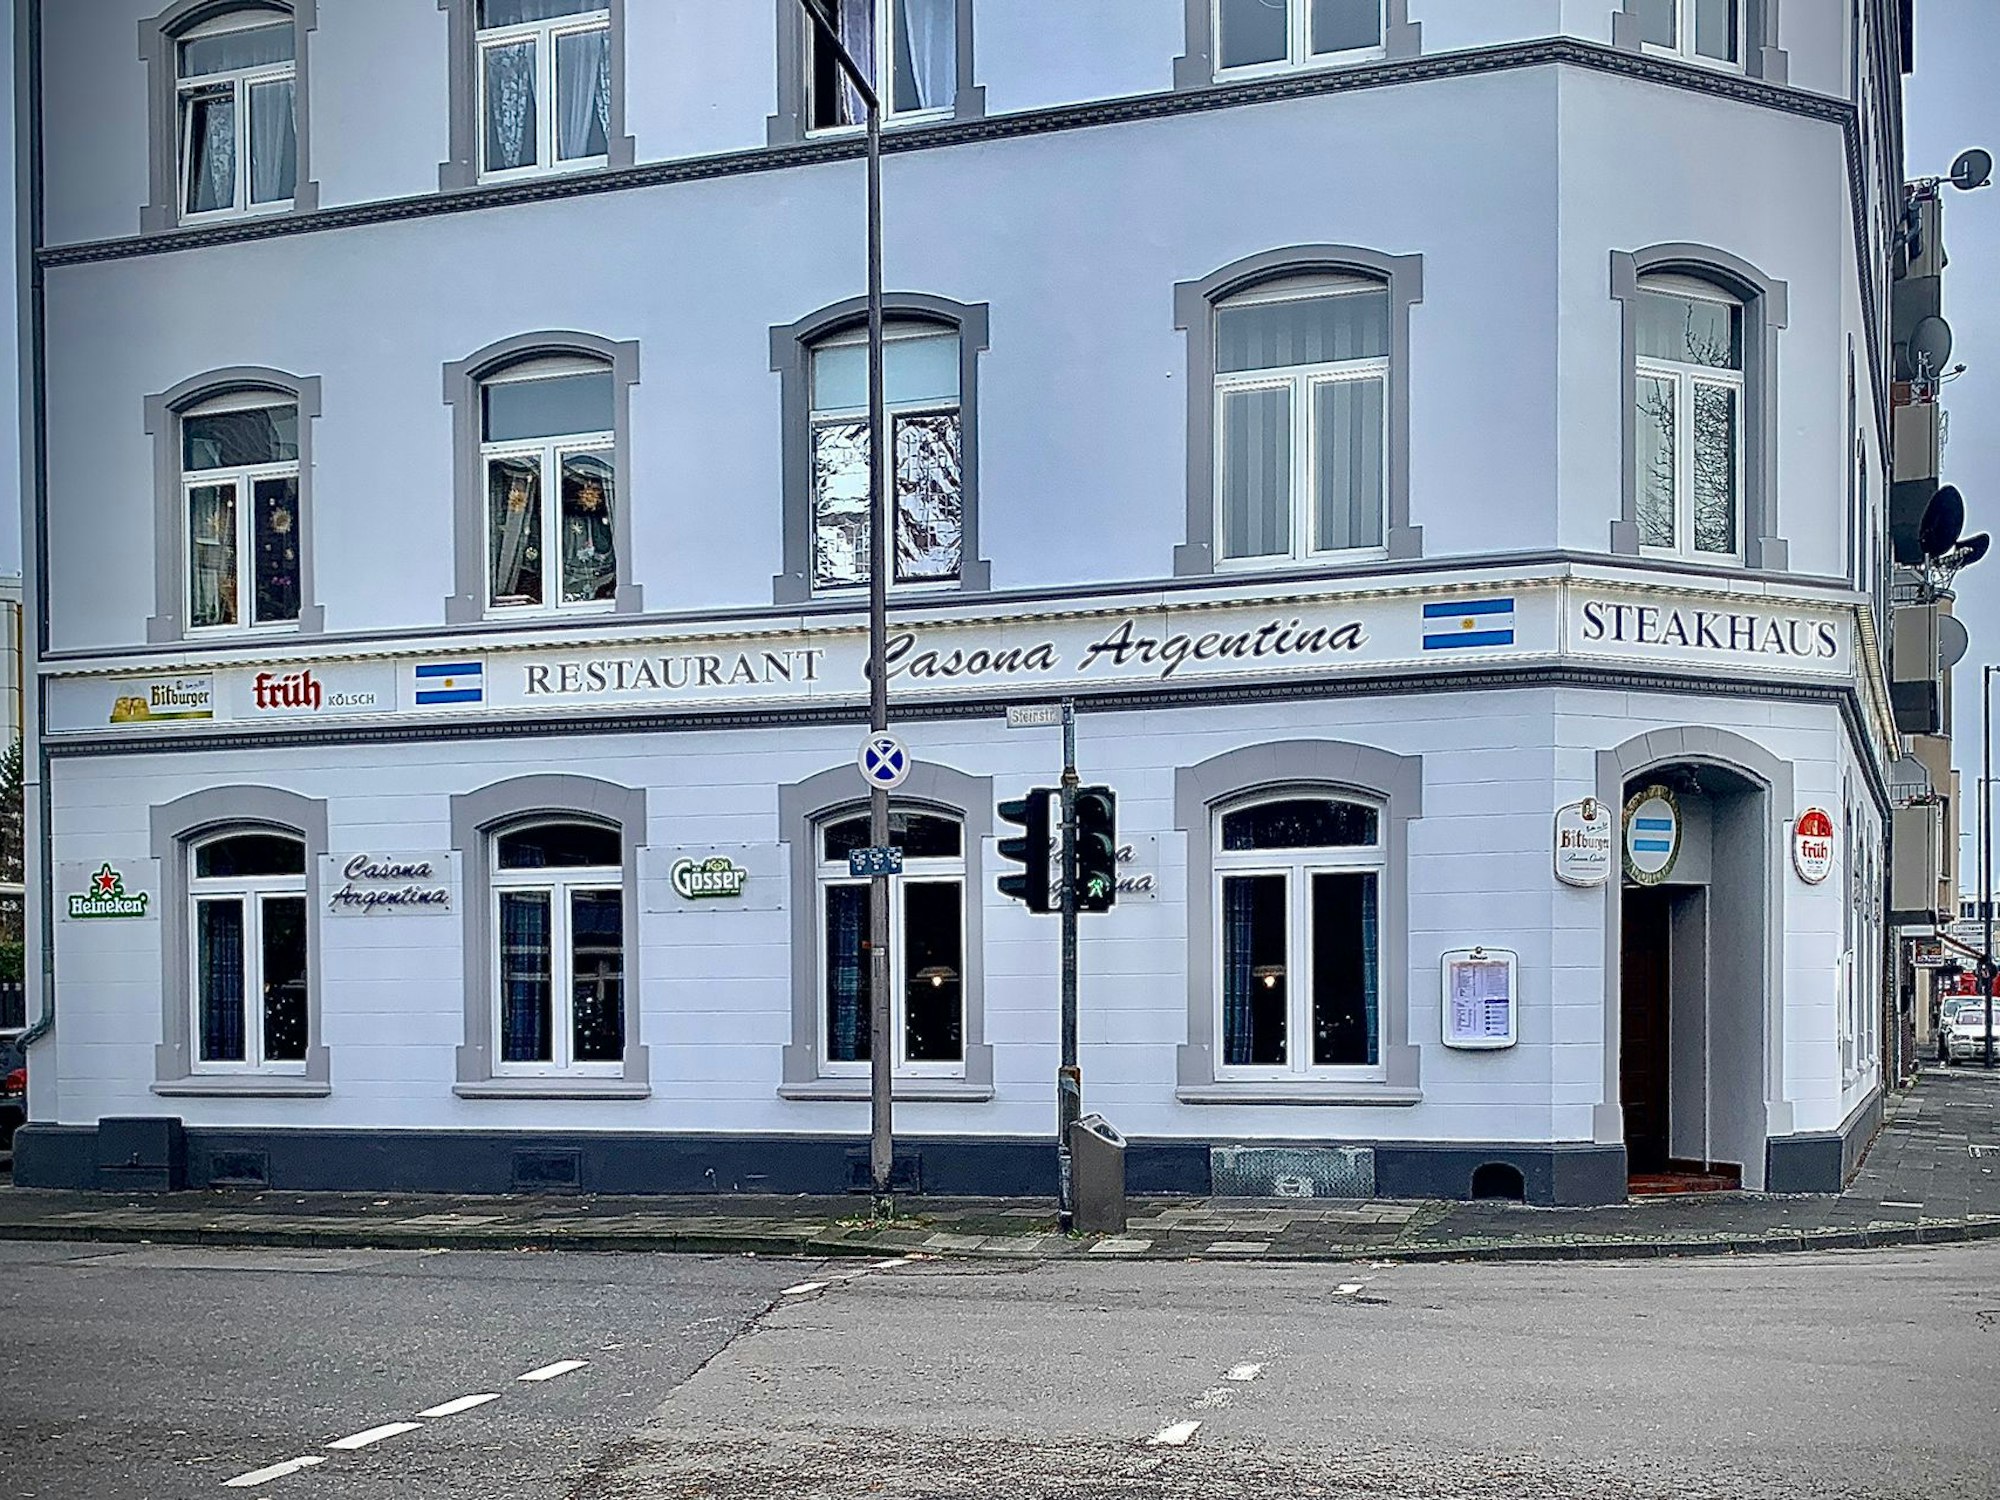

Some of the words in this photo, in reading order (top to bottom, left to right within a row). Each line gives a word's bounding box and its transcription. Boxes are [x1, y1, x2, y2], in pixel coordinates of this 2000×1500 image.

[1583, 601, 1838, 659] STEAKHAUS
[524, 649, 824, 695] RESTAURANT
[865, 632, 1061, 681] Casona
[1077, 618, 1368, 681] Argentina
[150, 684, 210, 708] Bitburger
[252, 669, 322, 711] früh
[328, 693, 375, 706] KÖLSCH
[1801, 840, 1828, 860] früh
[343, 854, 433, 880] Casona
[673, 861, 745, 896] Gösser
[71, 897, 143, 914] Heineken
[328, 882, 449, 914] Argentina
